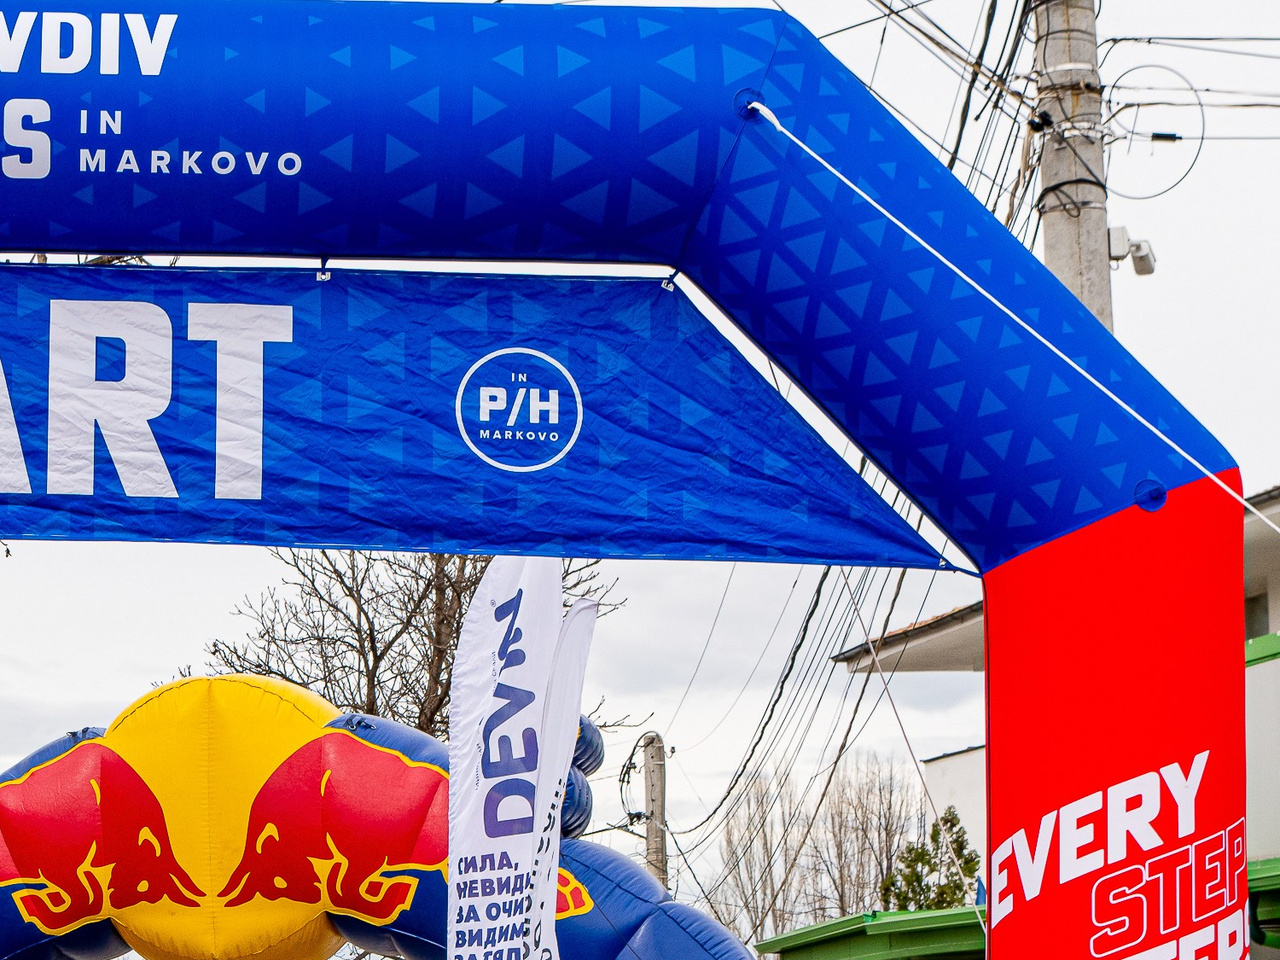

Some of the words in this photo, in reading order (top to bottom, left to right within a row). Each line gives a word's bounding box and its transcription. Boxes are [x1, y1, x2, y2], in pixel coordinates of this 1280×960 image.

[79, 110, 123, 136] IN
[79, 149, 304, 177] MARKOVO
[511, 372, 527, 382] IN
[479, 386, 559, 427] P/H
[479, 429, 559, 441] MARKOVO
[991, 749, 1210, 930] EVERY
[1089, 816, 1247, 959] STEP
